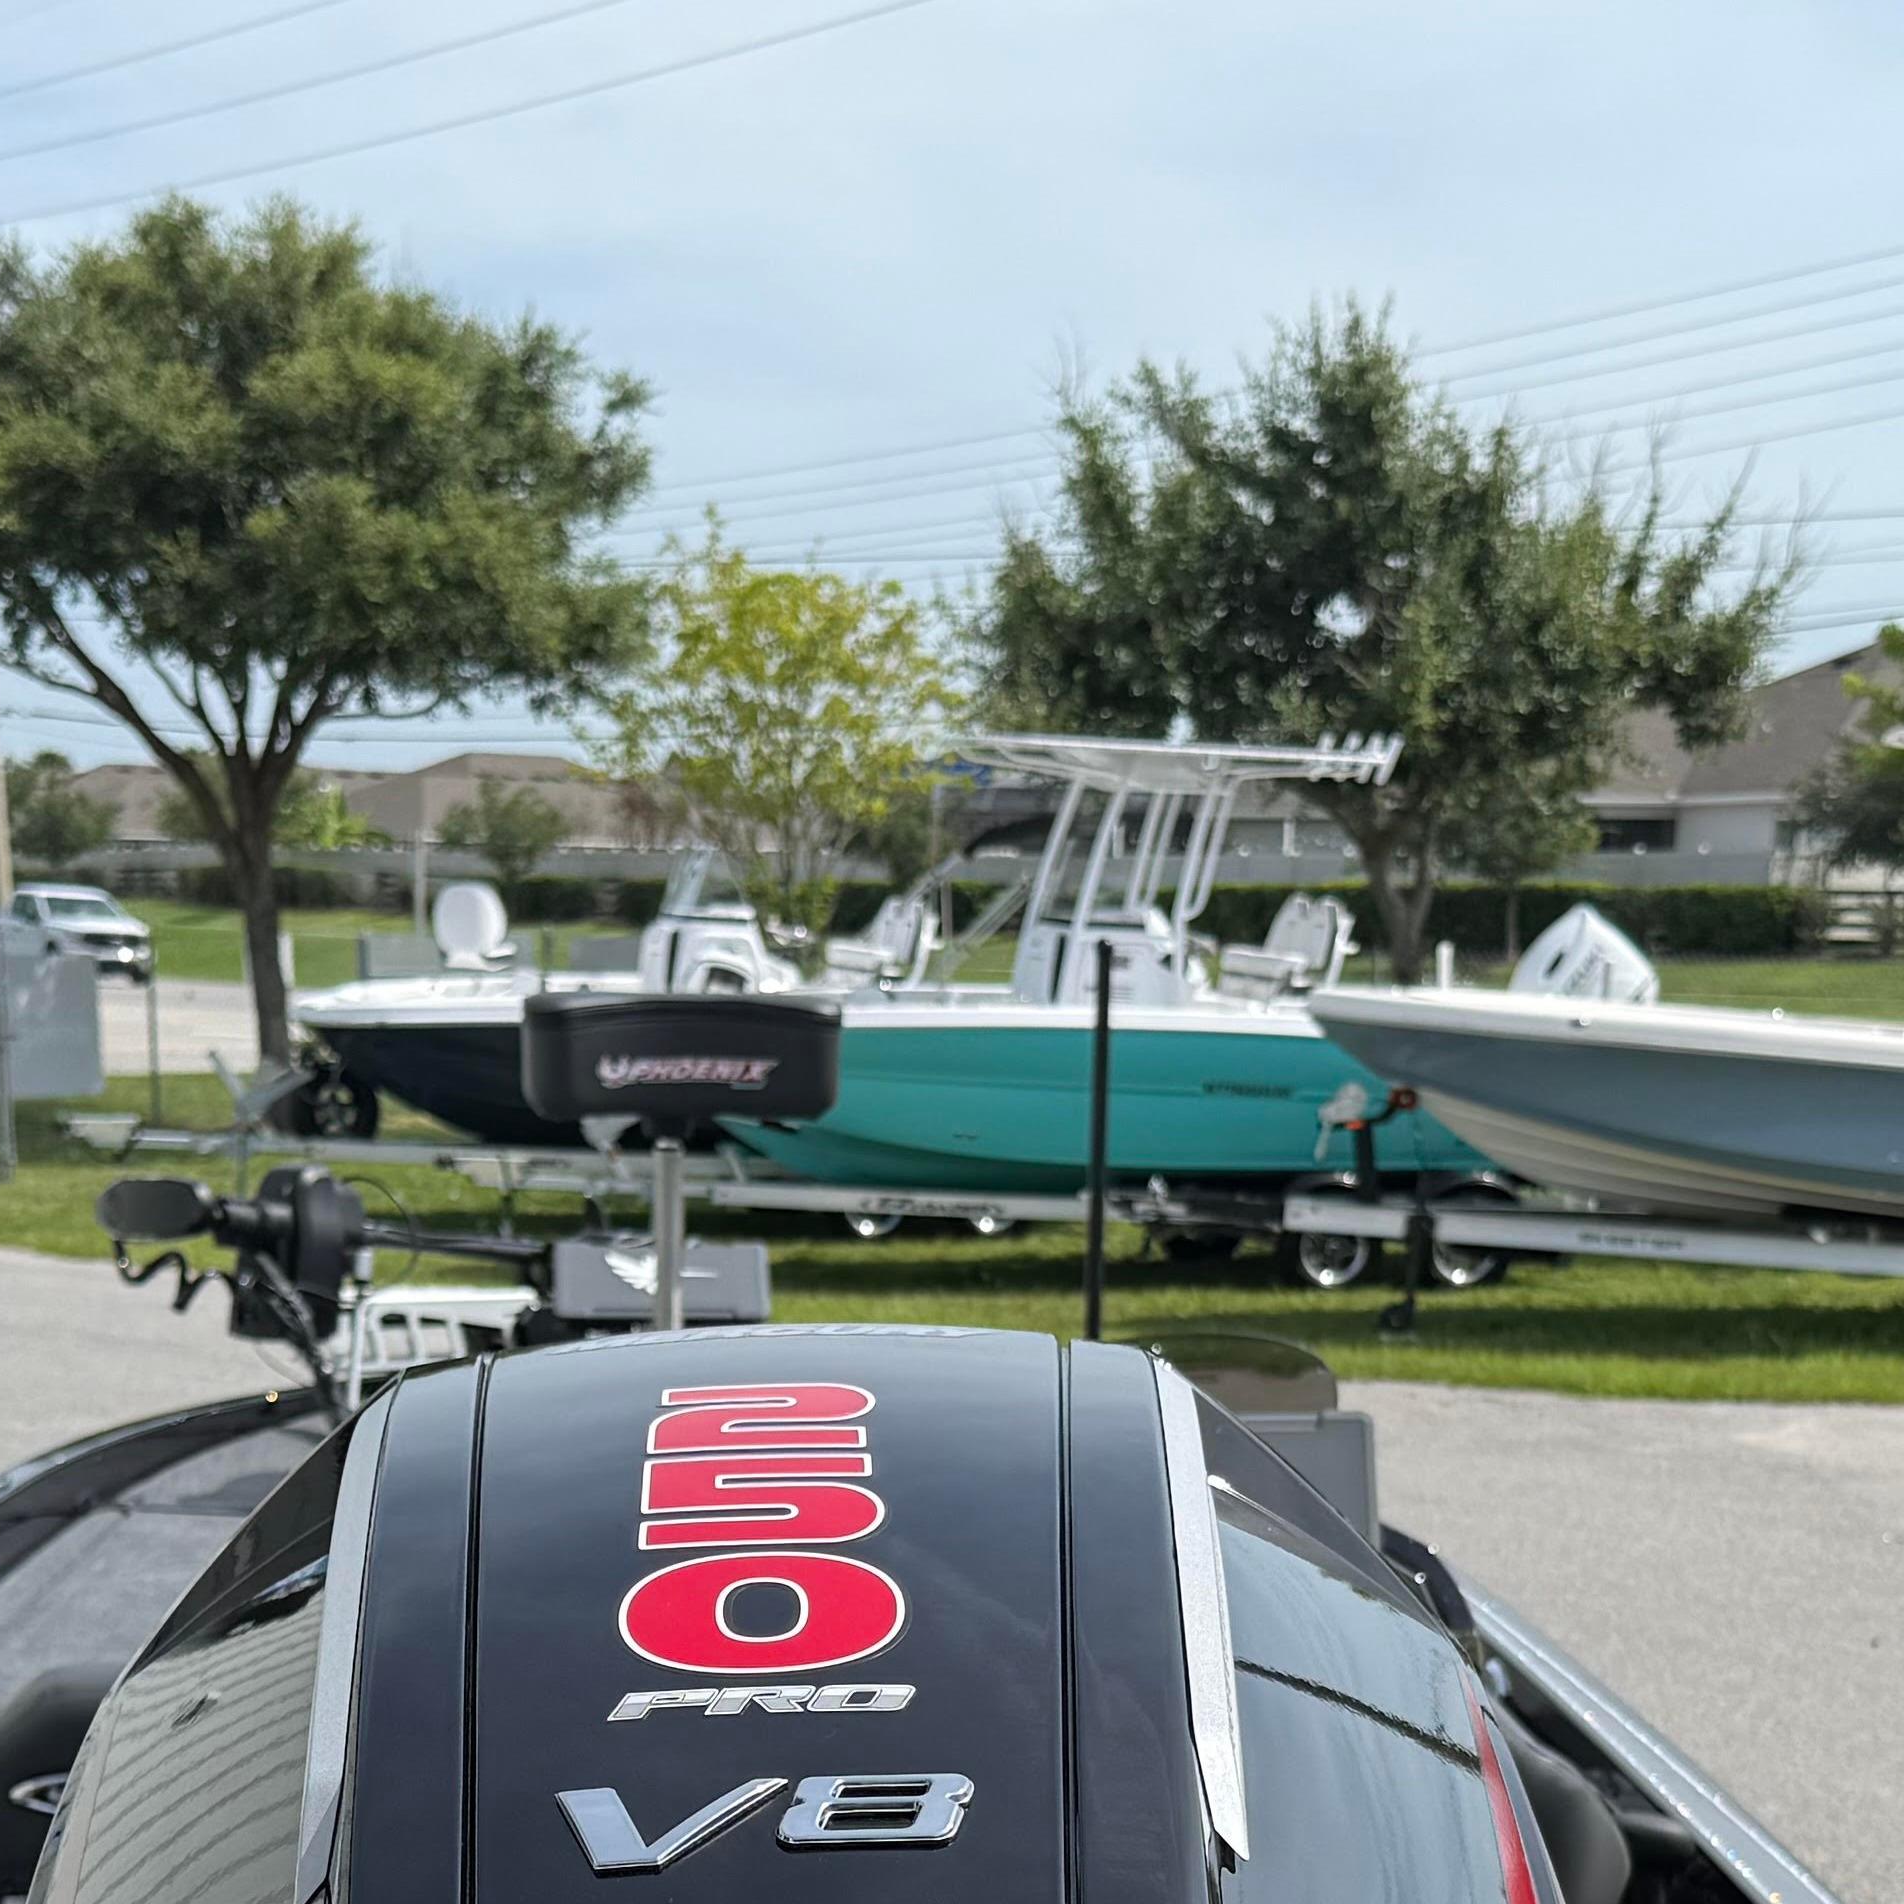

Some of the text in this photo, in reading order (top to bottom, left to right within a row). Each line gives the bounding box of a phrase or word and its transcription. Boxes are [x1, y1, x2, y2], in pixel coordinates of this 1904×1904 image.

[617, 1382, 907, 1676] 250
[606, 1683, 917, 1723] PRO
[553, 1772, 976, 1878] V8
